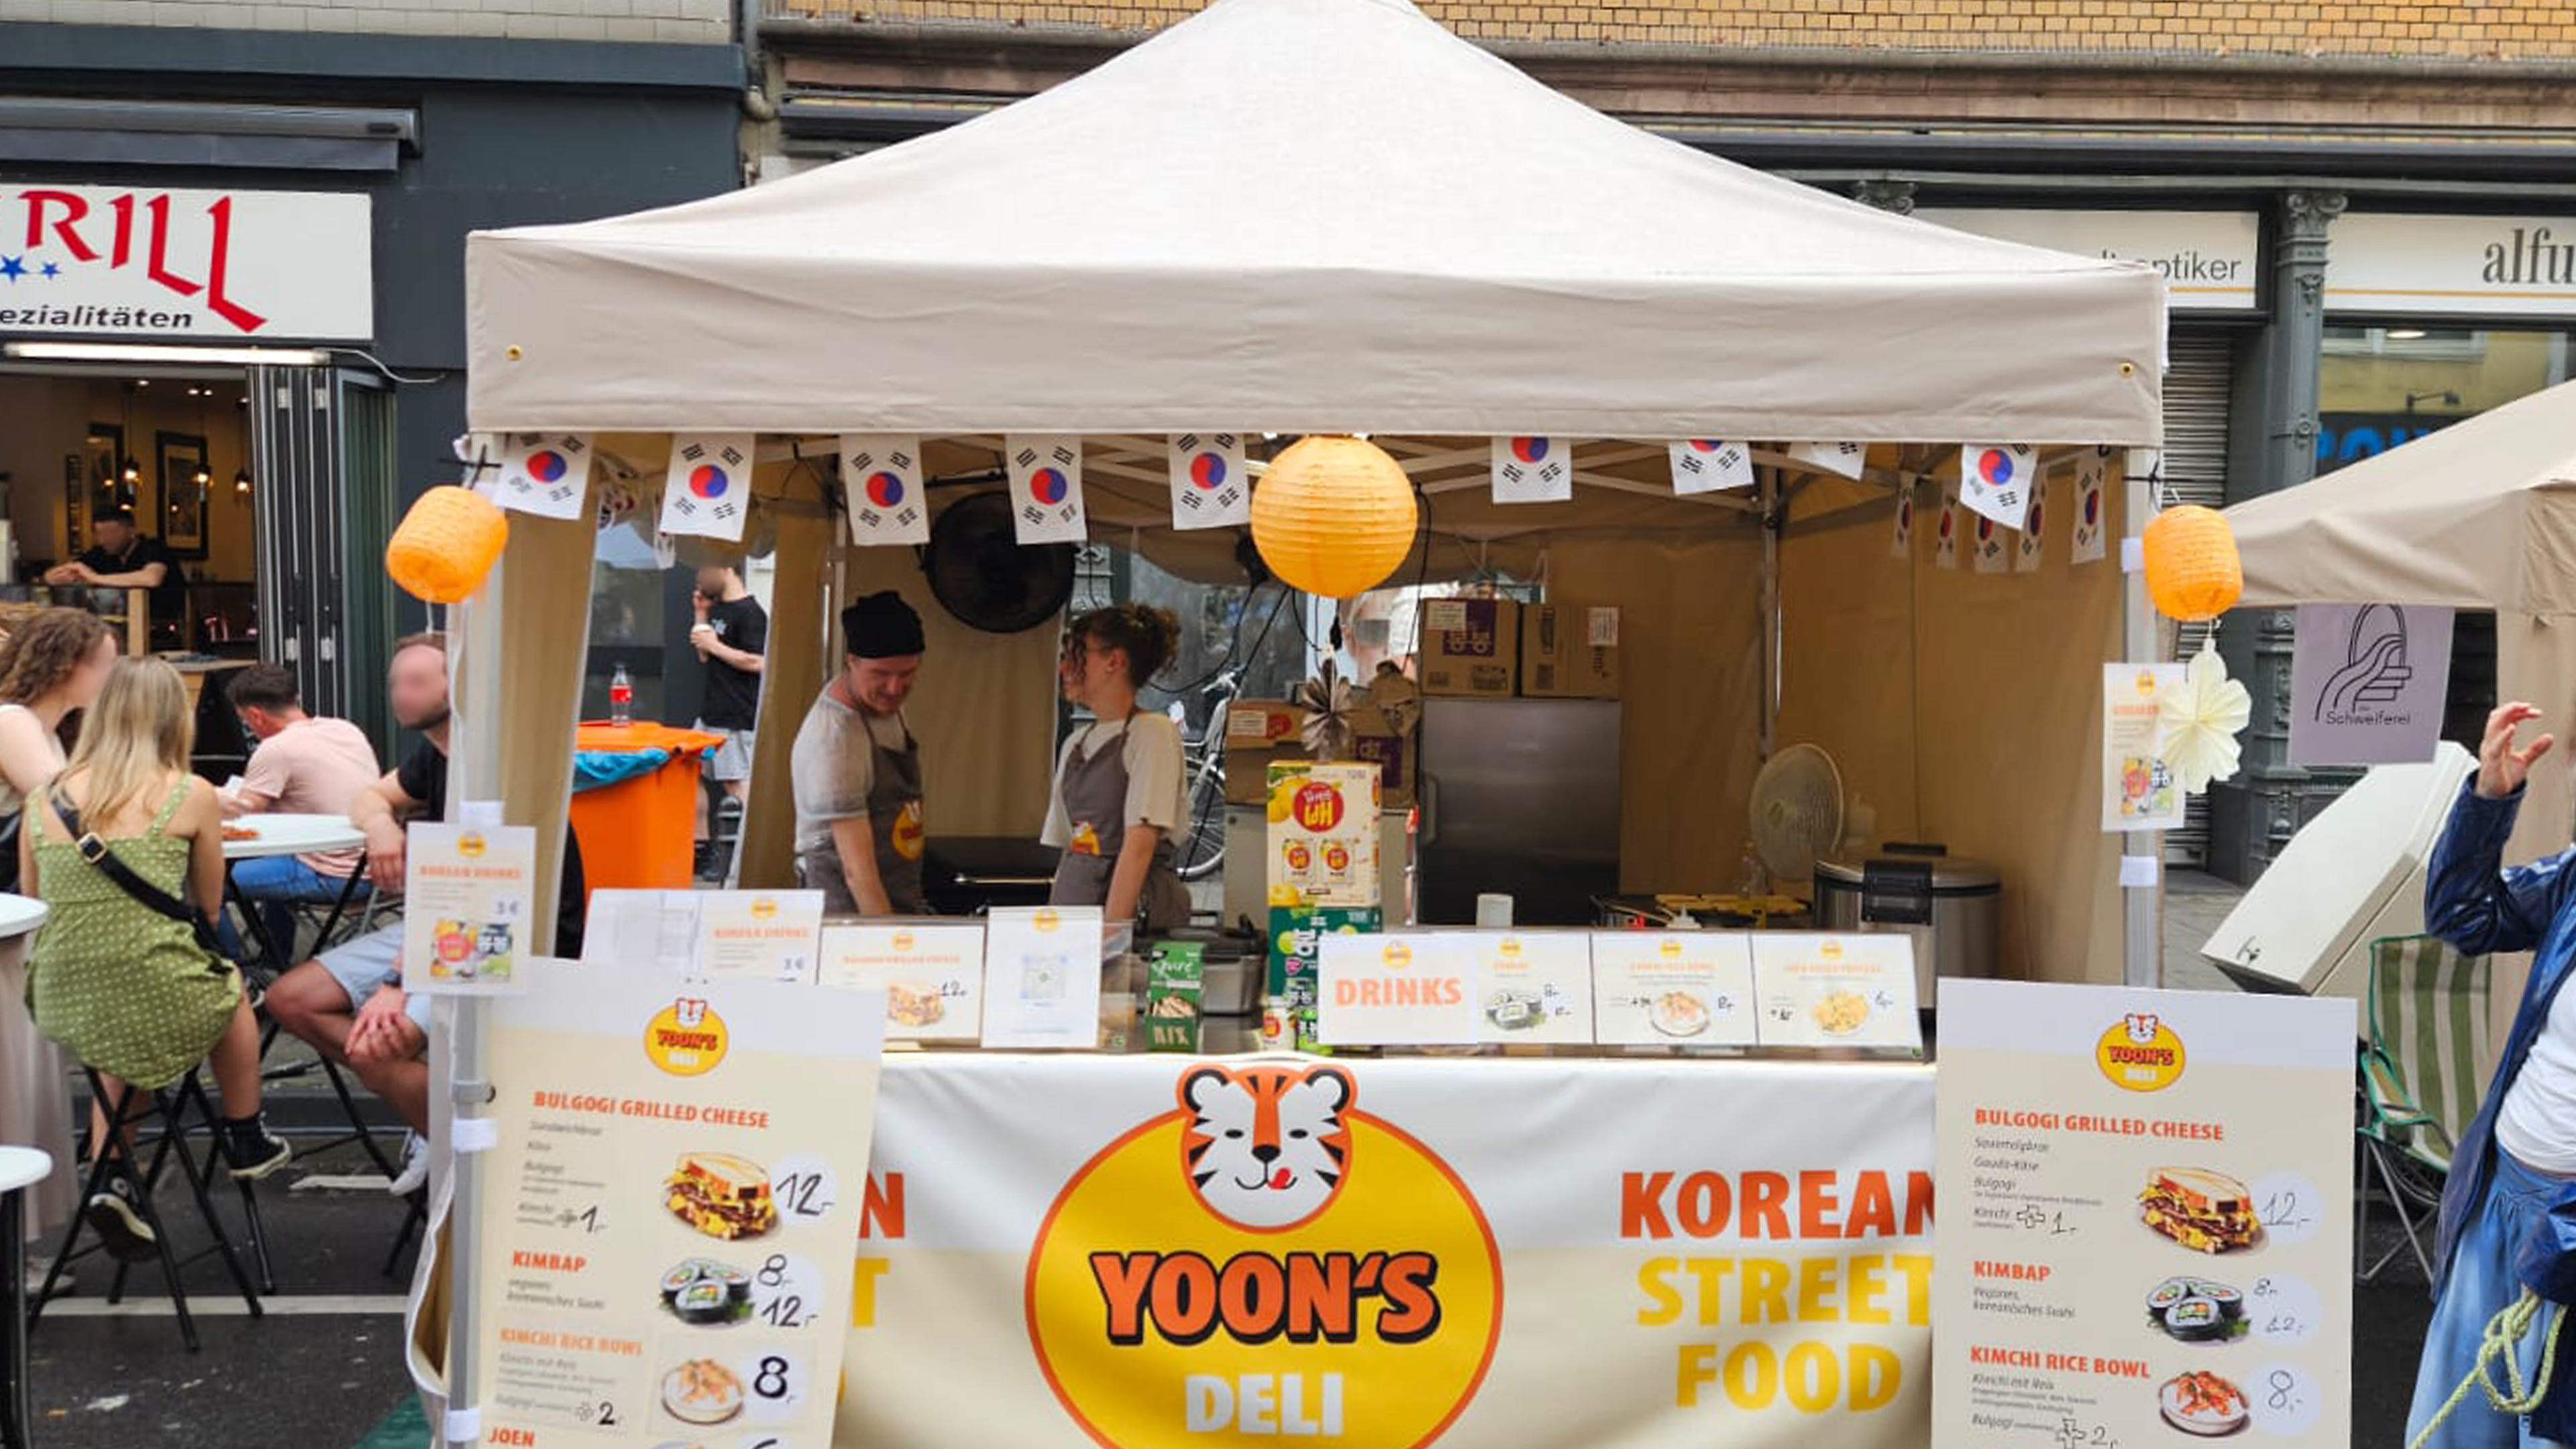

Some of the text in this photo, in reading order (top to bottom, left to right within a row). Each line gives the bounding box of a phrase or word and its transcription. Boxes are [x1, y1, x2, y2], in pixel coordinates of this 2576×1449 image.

[0, 190, 268, 333] RILL
[2483, 227, 2575, 284] alfu
[1335, 977, 1462, 1006] DRINKS
[534, 1091, 770, 1128] BULGOGI GRILLED CHEESE
[1976, 1109, 2224, 1140] BULGOGI GRILLED CHEESE
[1620, 1169, 1935, 1240] KOREAN
[513, 1250, 587, 1272] KIMBAP
[1974, 1260, 2051, 1282] KIMBAP
[1088, 1250, 1442, 1346] YOON'S
[1635, 1254, 1933, 1327] STREET
[500, 1328, 644, 1356] KIMCHI RICE BOWL
[1676, 1340, 1902, 1414] FOOD
[1970, 1346, 2150, 1379] KIMCHI RICE BOWL
[1184, 1373, 1343, 1437] DELI
[489, 1427, 535, 1447] JOEN
